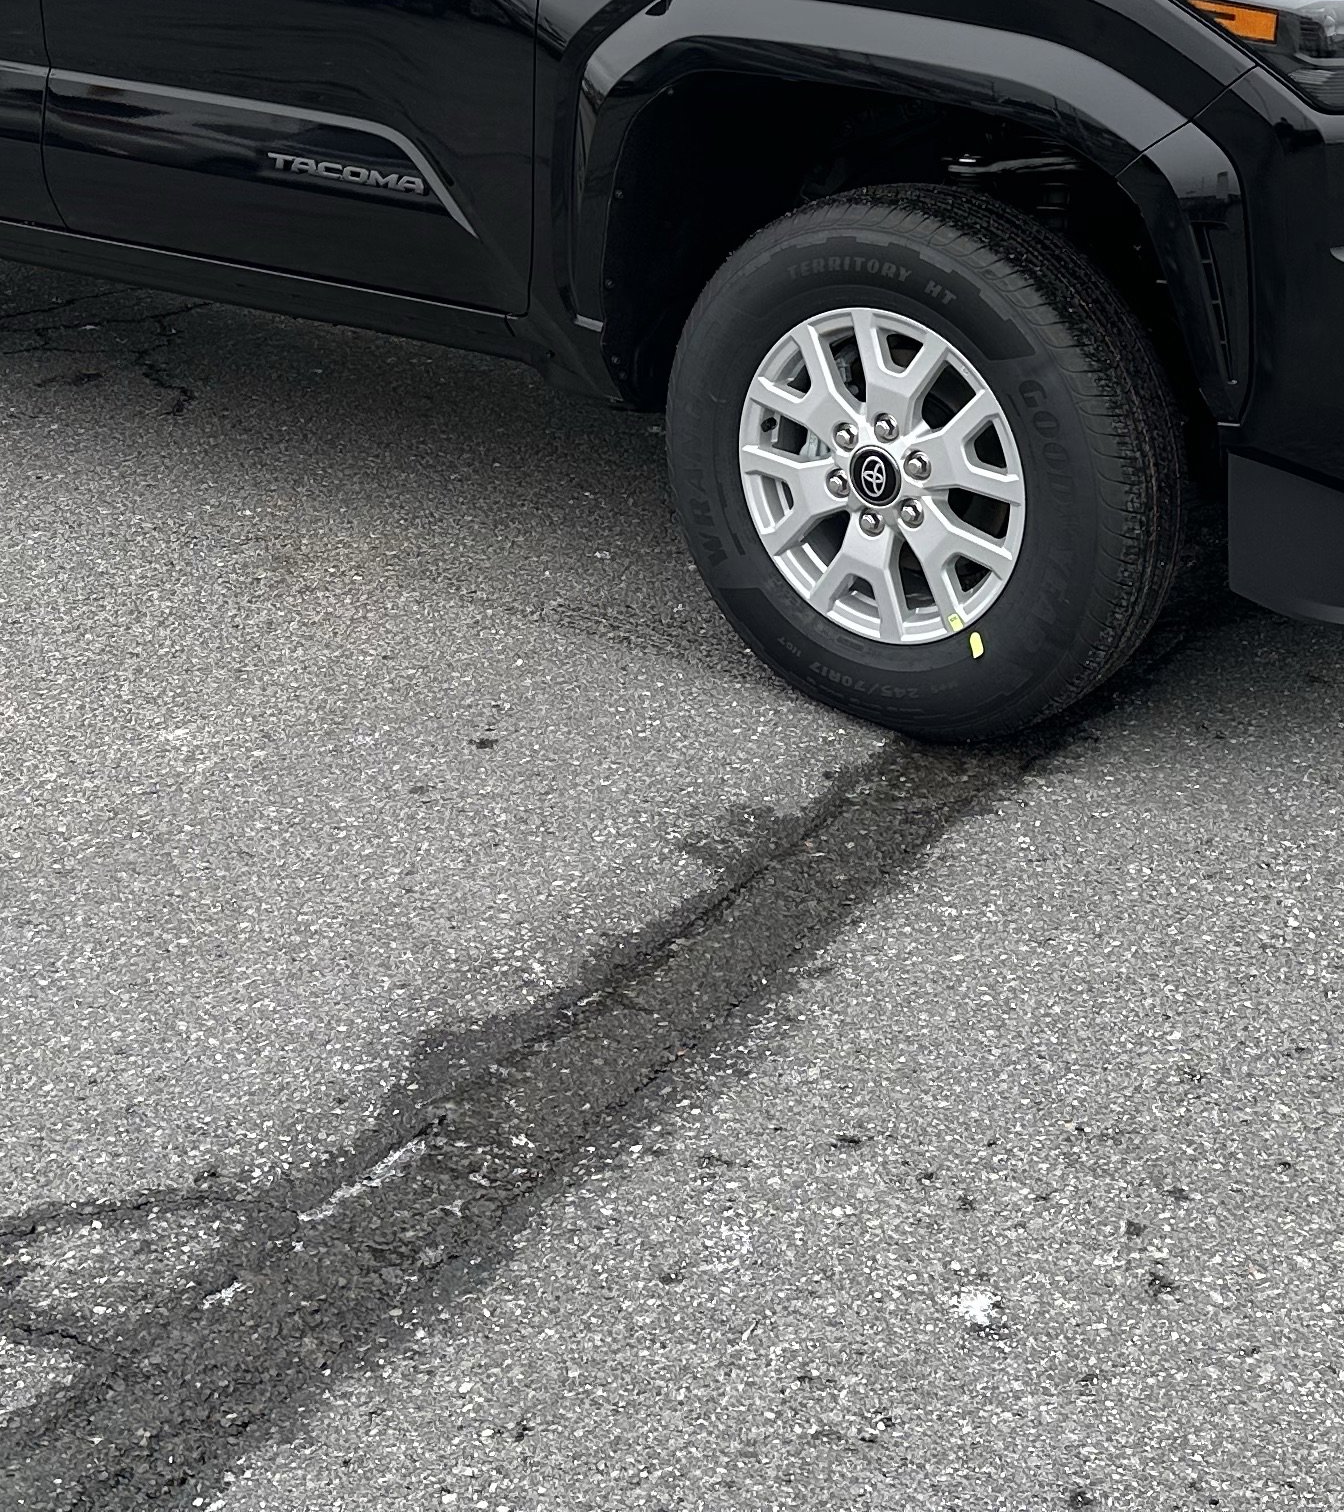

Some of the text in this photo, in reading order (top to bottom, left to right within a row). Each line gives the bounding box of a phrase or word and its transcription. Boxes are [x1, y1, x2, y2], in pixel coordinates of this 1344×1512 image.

[267, 151, 425, 196] TACOMA
[786, 255, 958, 306] TERRITORY HT
[807, 660, 921, 699] 245/70R17
